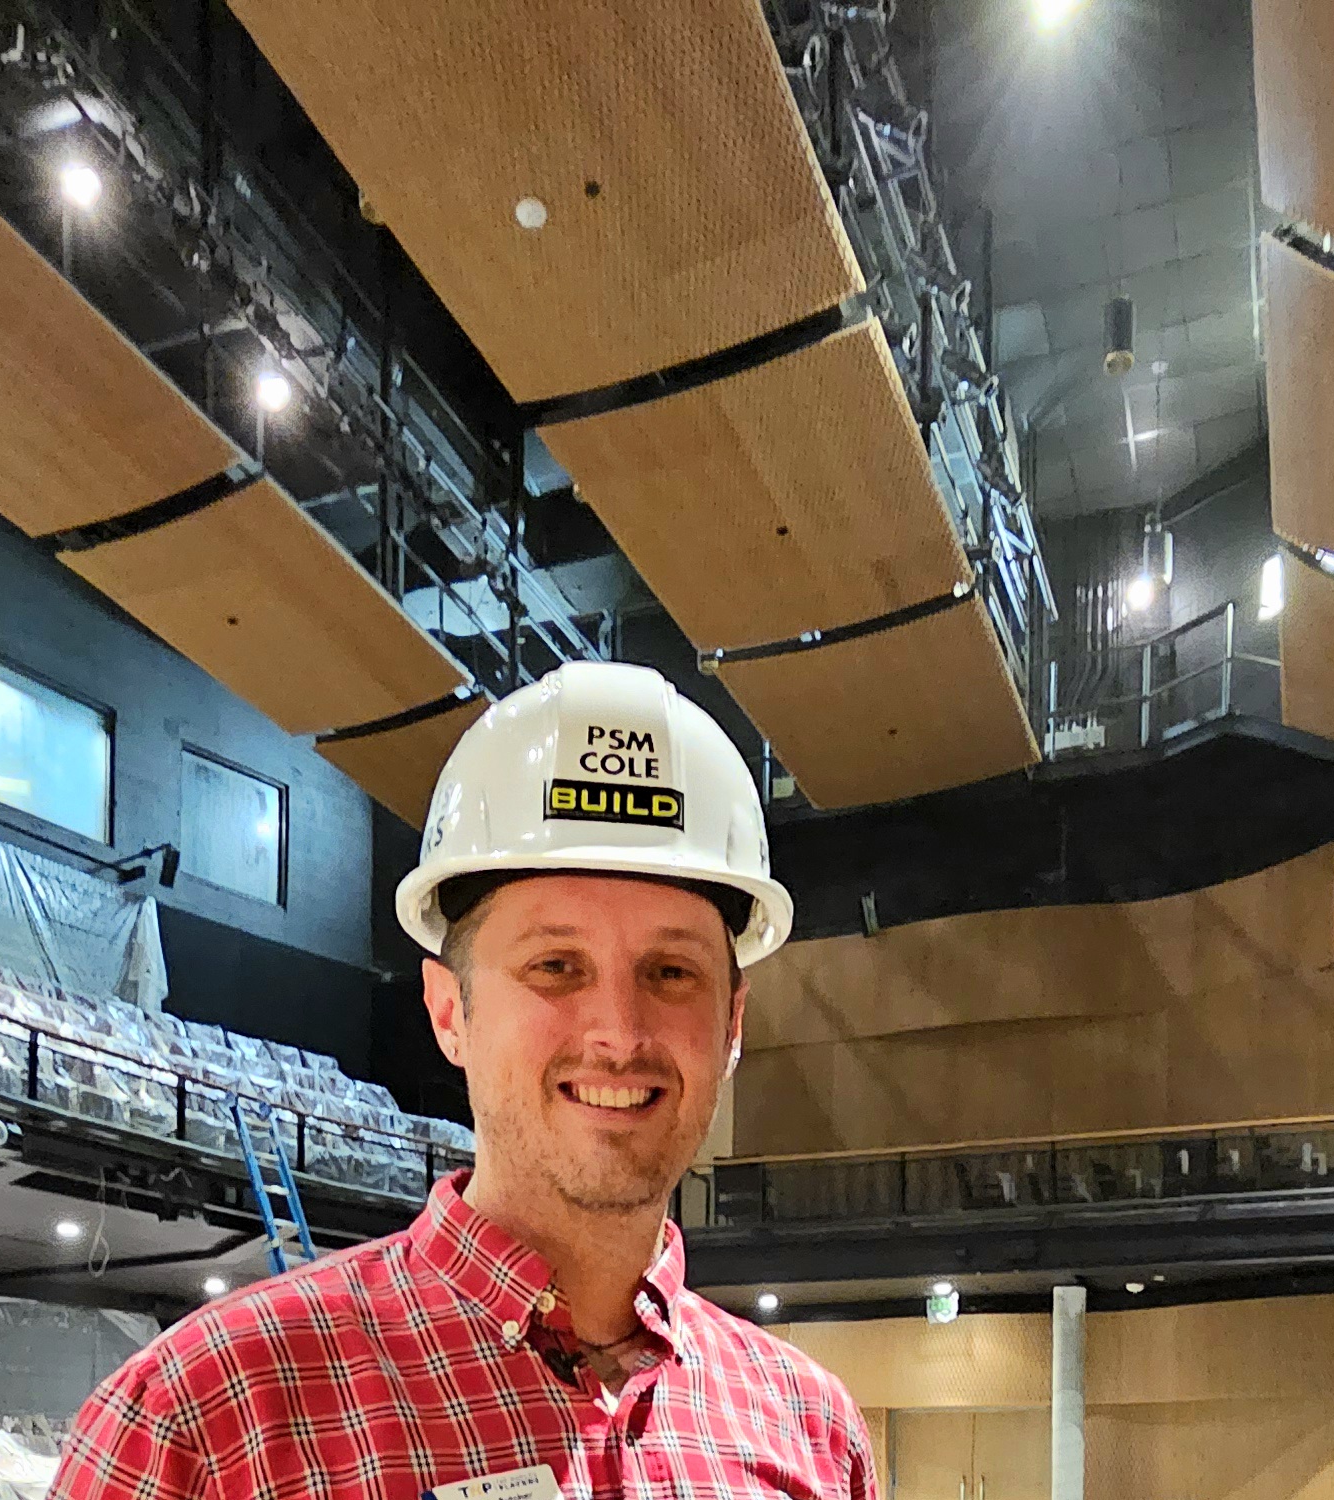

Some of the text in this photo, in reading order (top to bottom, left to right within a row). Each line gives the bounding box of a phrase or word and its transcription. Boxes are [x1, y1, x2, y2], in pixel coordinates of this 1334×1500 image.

[587, 725, 655, 753] PSM
[579, 751, 659, 779] COLE
[551, 786, 679, 817] BUILD
